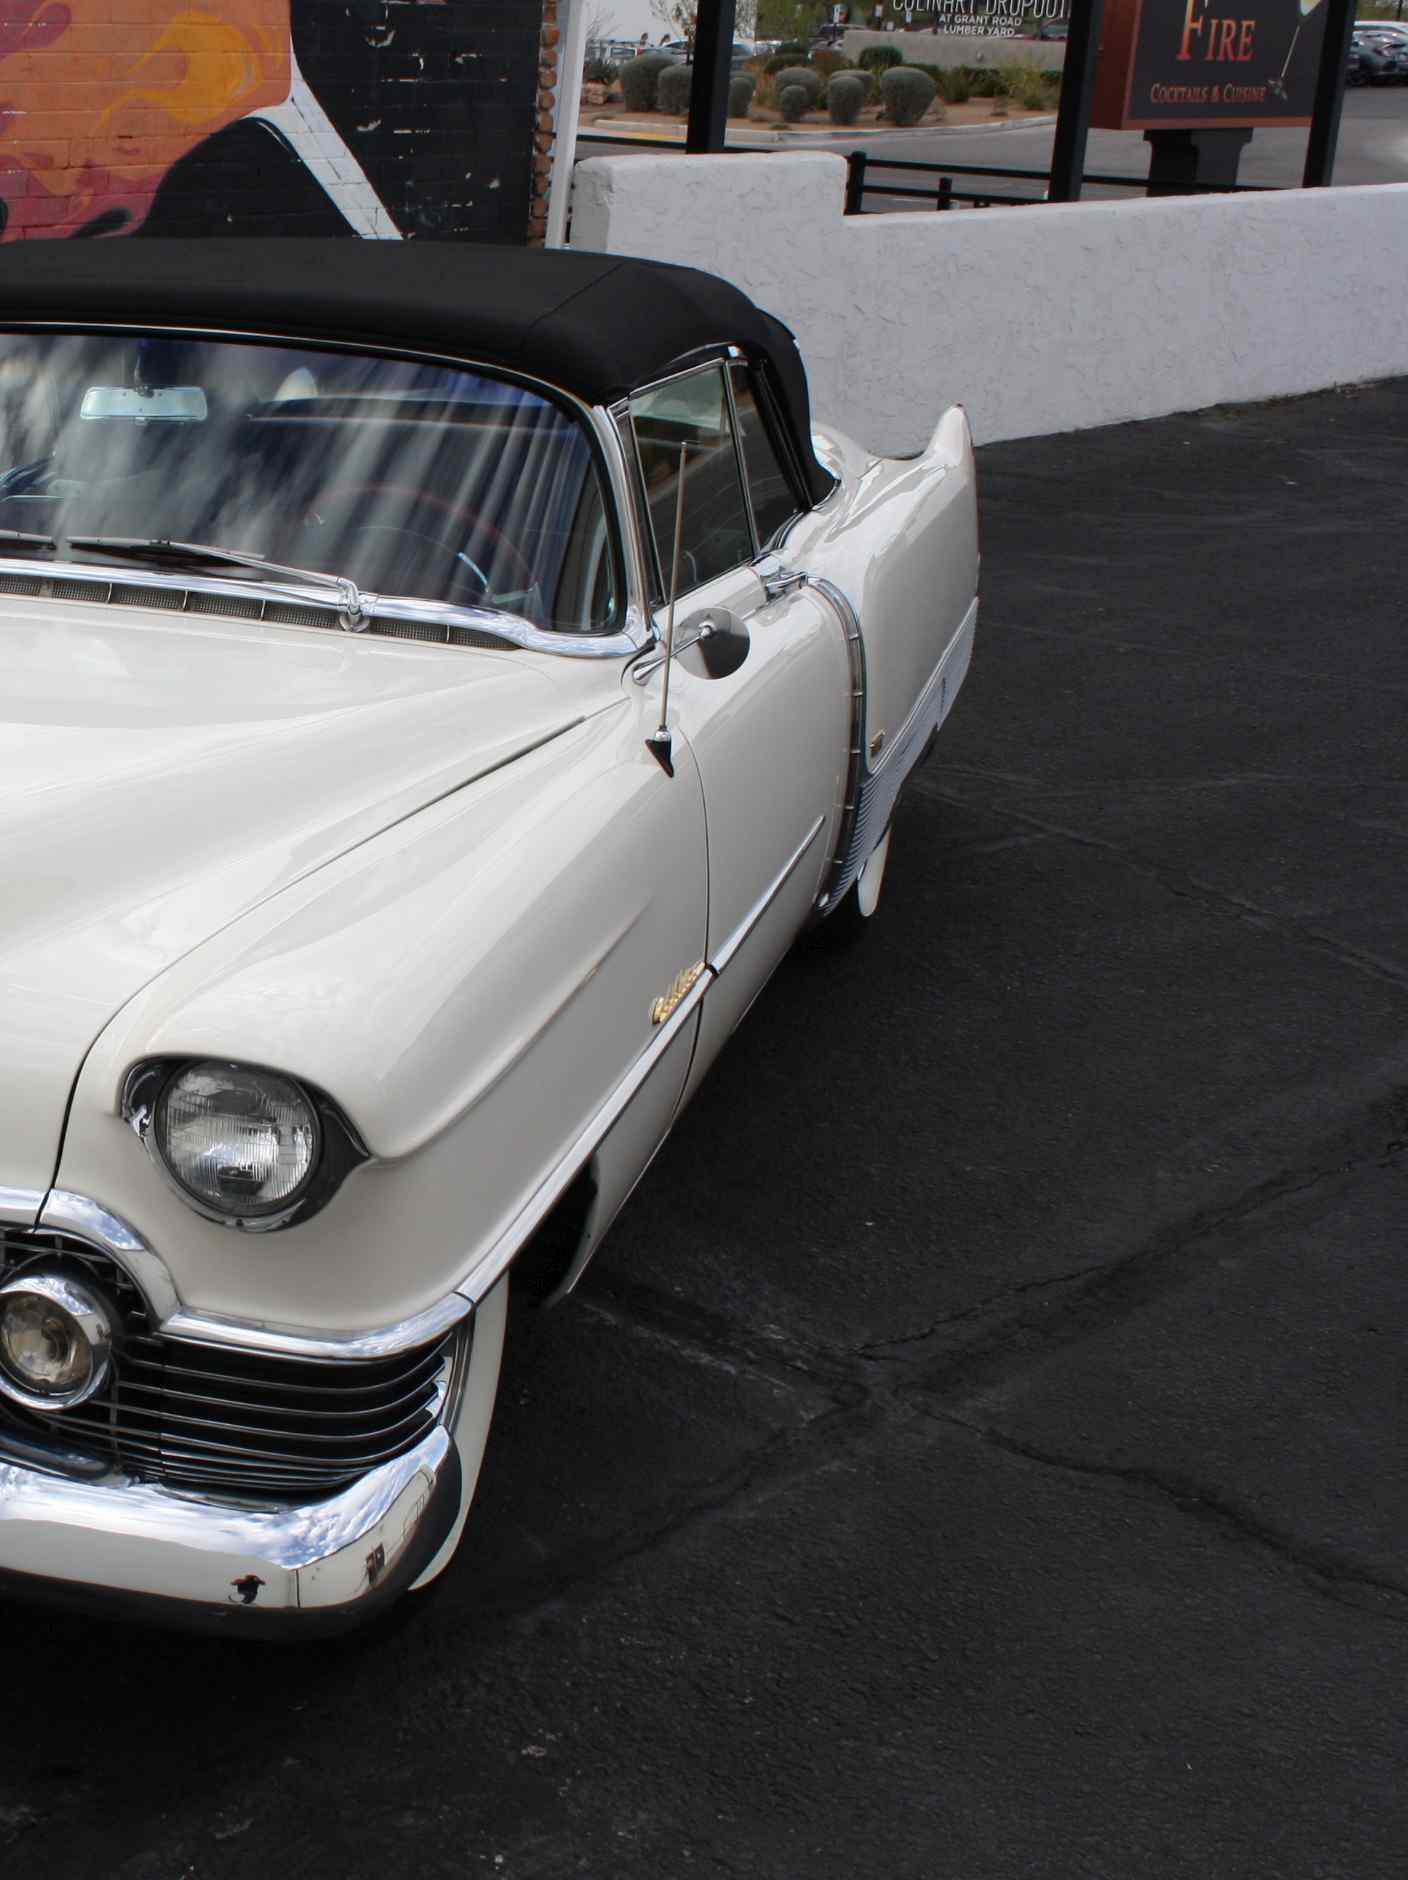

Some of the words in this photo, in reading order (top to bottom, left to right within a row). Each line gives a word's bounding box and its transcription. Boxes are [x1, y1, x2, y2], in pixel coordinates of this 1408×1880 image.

[939, 13, 953, 24] AT
[954, 15, 990, 26] GRANT
[992, 16, 1023, 27] ROAD
[943, 25, 985, 36] LUMBER
[987, 27, 1016, 38] YARD
[1176, 0, 1256, 61] FIRE
[1151, 83, 1209, 103] COCKTAILS
[1224, 83, 1267, 103] CUISINE
